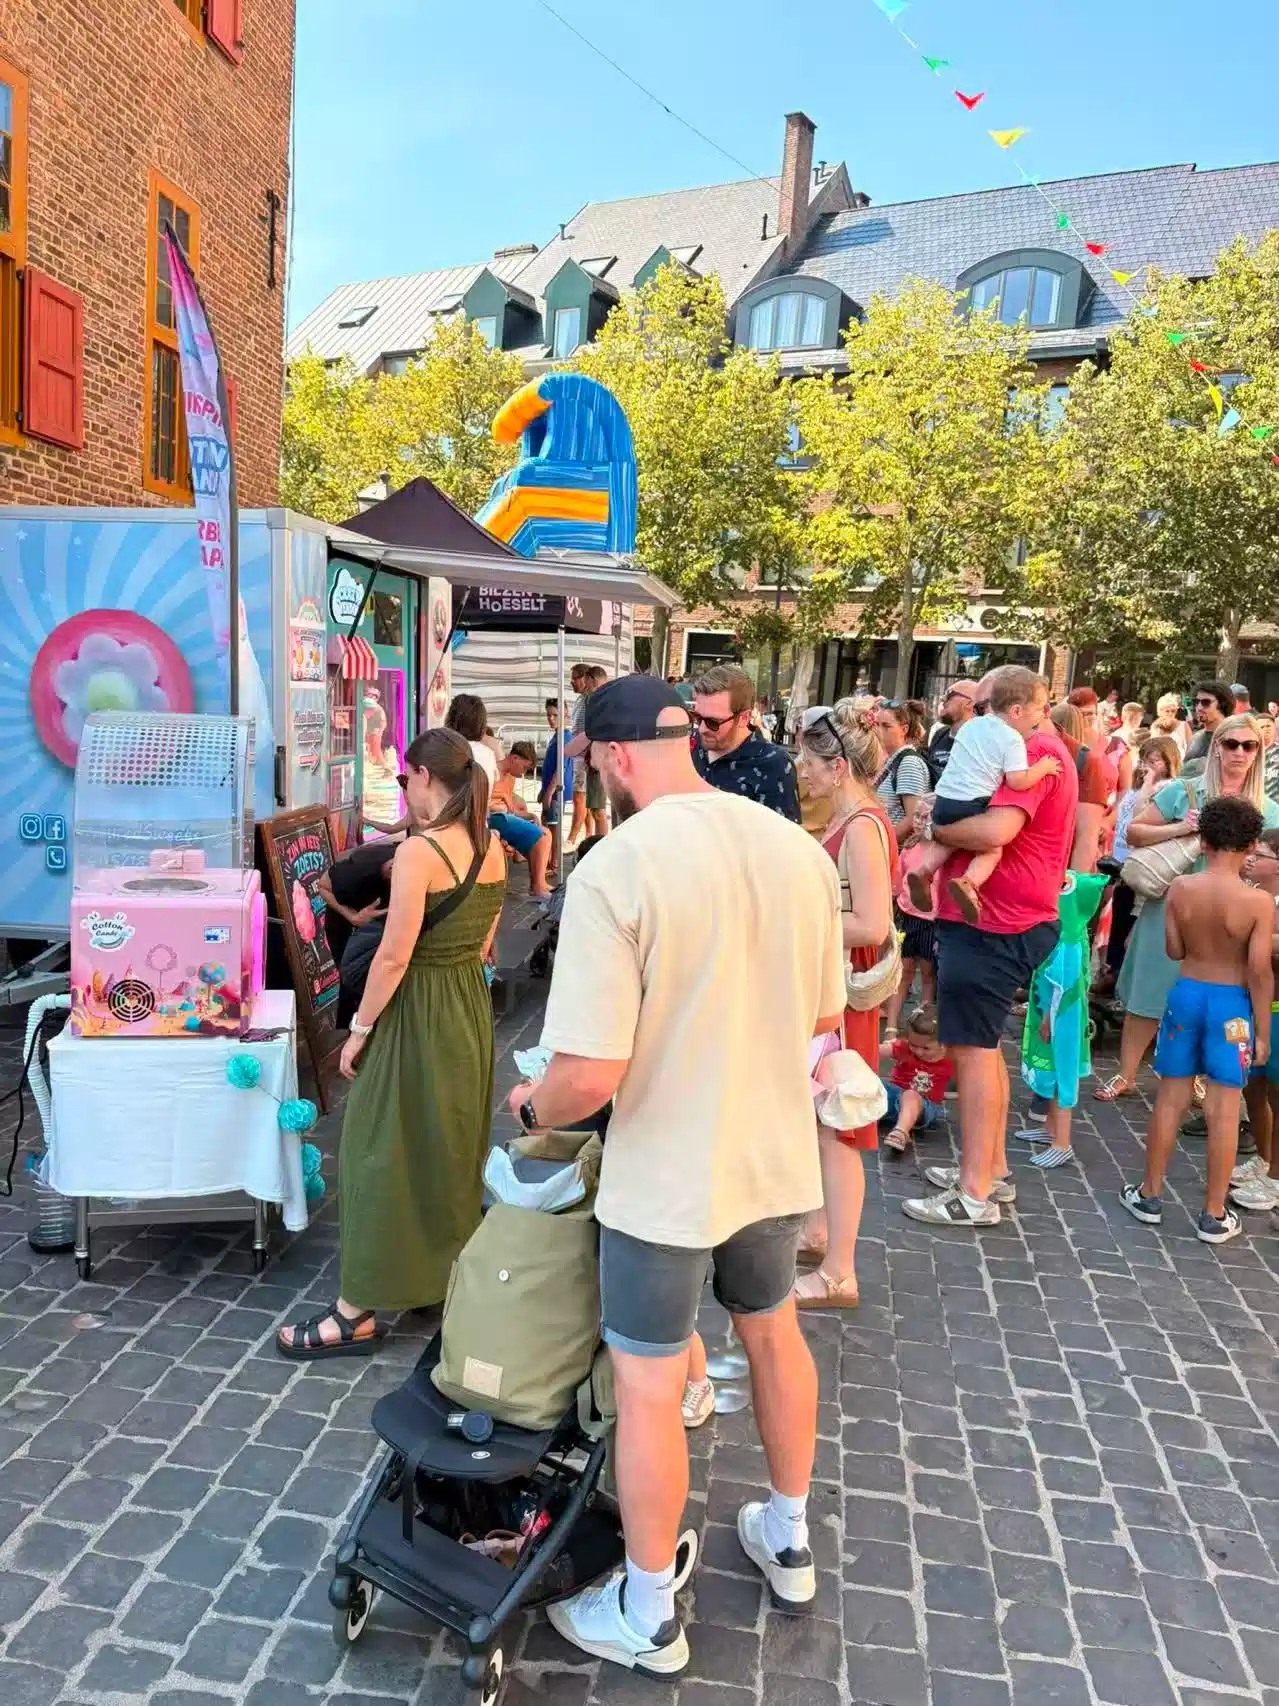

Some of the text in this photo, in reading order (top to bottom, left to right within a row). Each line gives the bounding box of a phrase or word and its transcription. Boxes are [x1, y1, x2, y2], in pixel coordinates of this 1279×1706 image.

[479, 597, 547, 612] HOESELT
[294, 851, 324, 879] ZOETS?
[92, 921, 124, 931] Cotton
